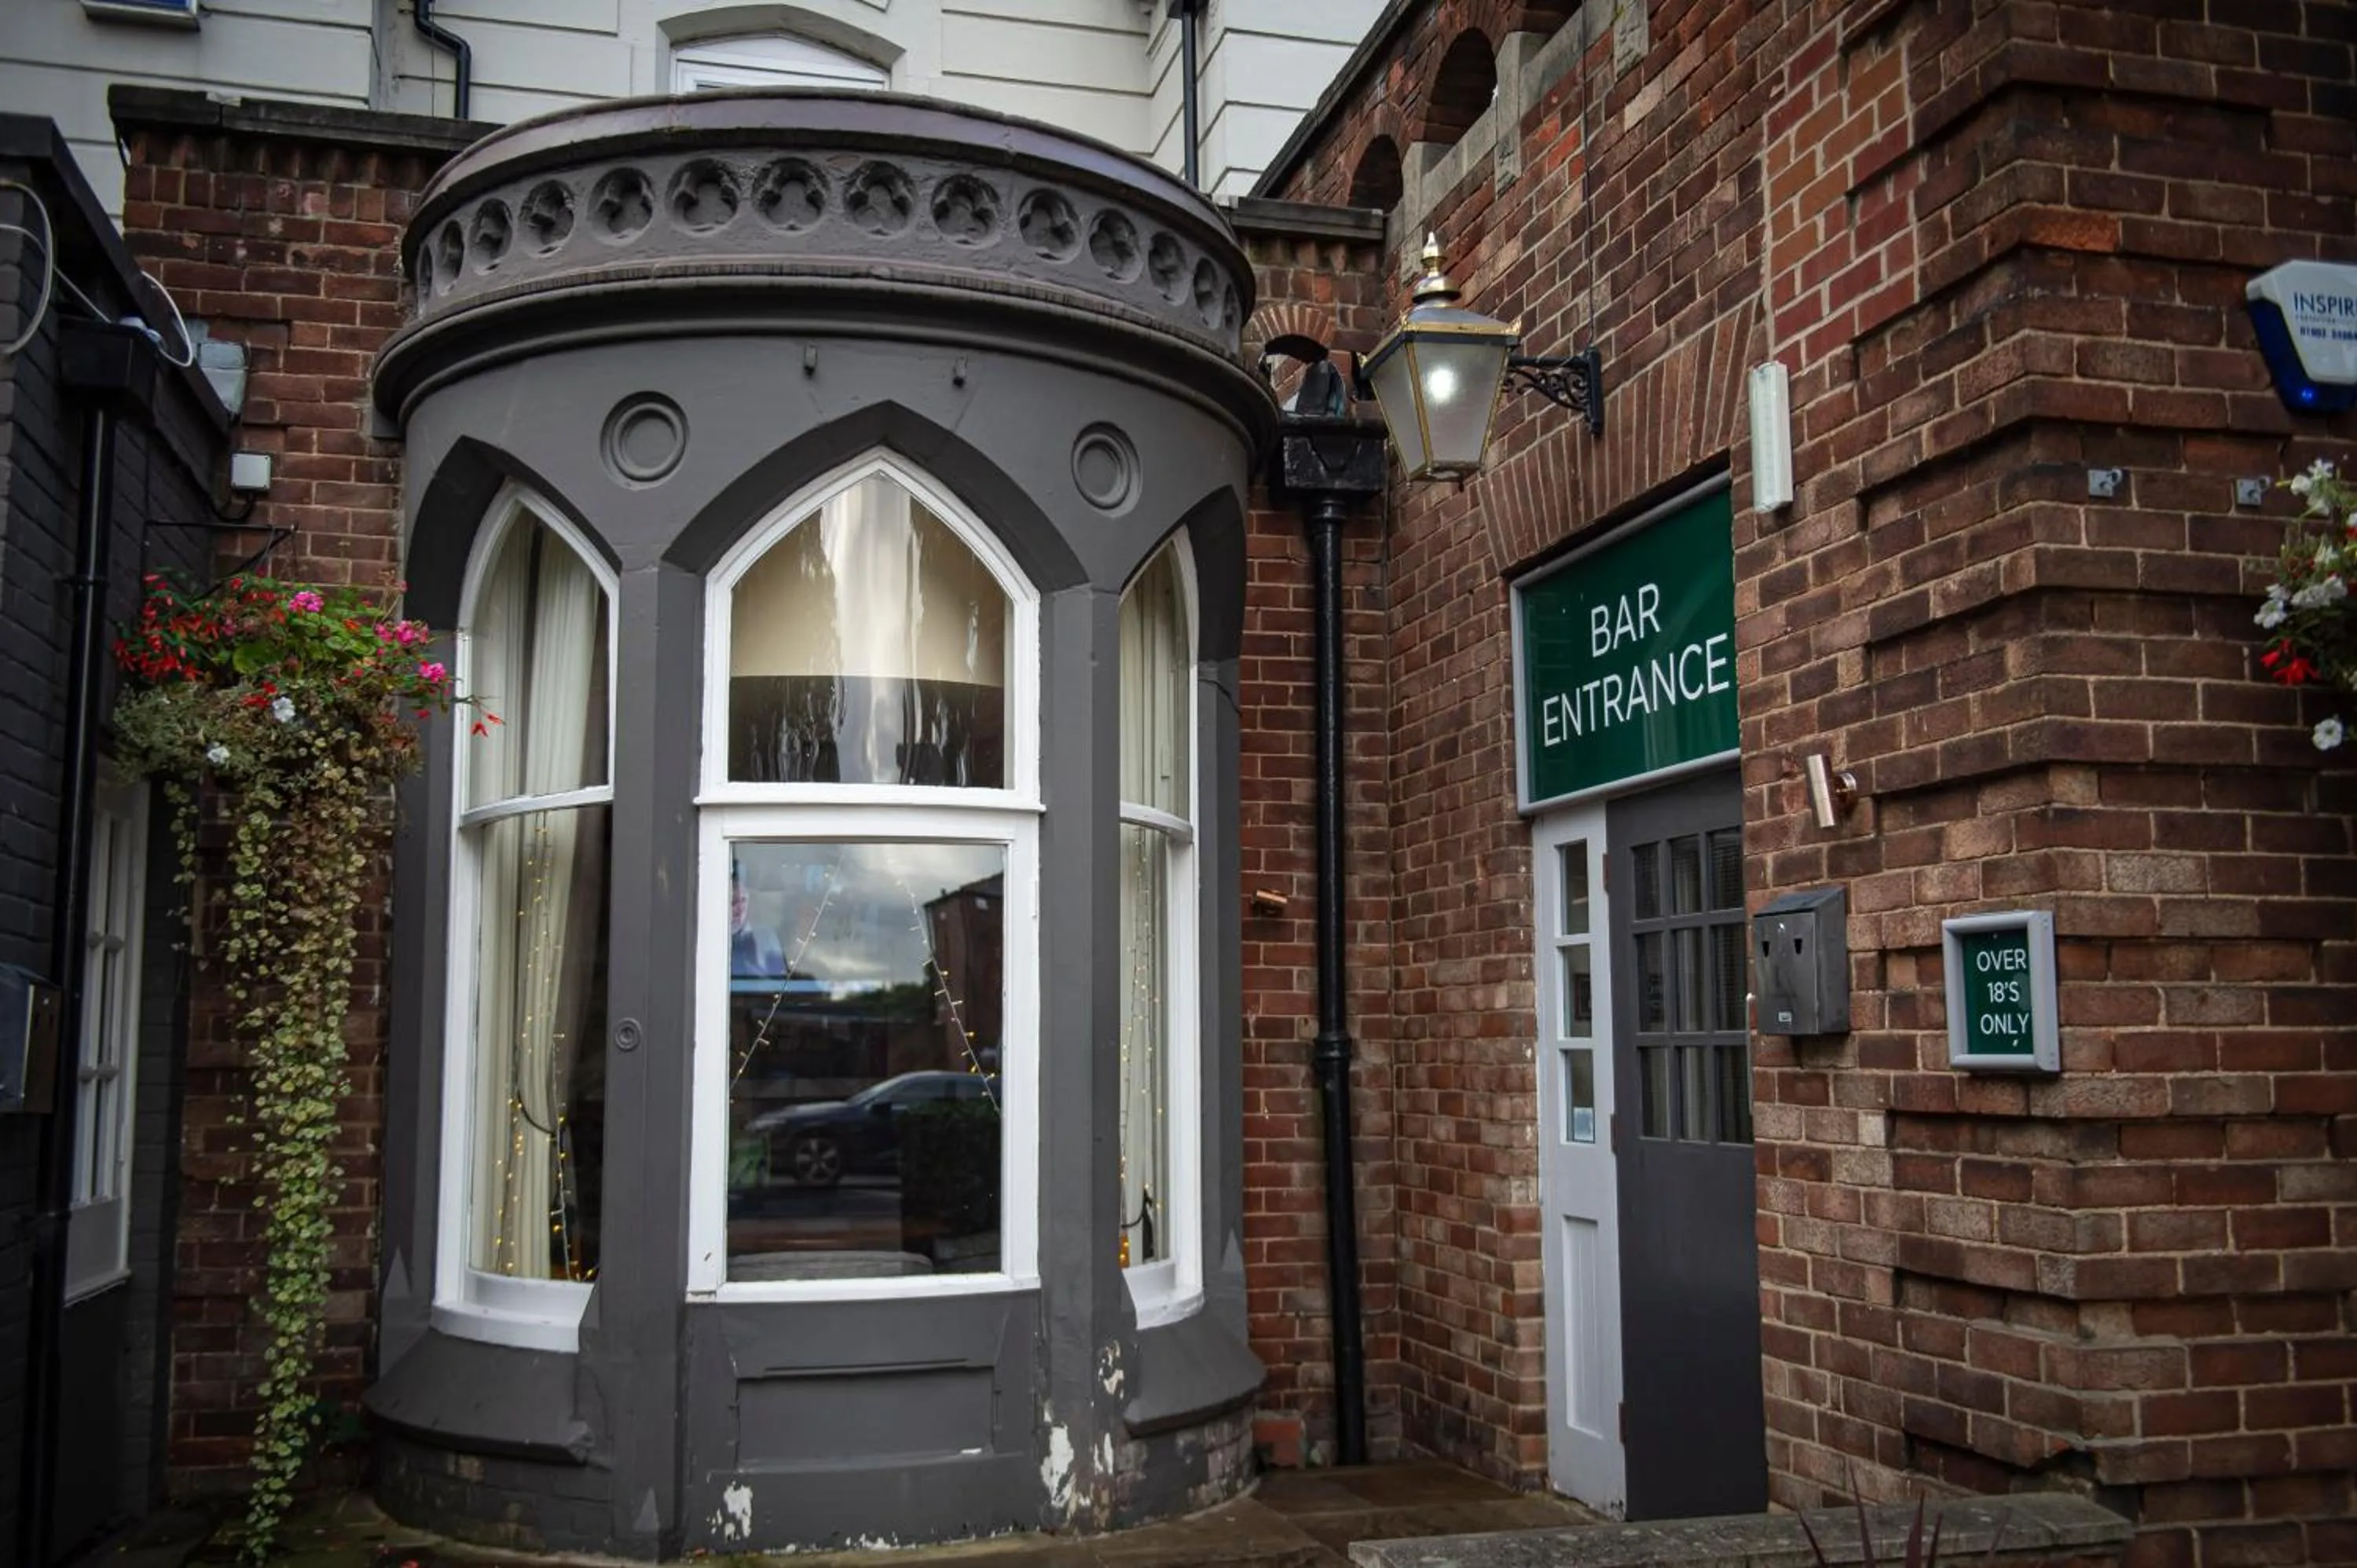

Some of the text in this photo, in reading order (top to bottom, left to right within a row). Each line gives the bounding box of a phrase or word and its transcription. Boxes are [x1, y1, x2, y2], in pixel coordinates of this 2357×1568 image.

[2293, 291, 2357, 317] INSPIR
[1591, 583, 1660, 658] BAR
[1543, 633, 1729, 747] ENTRANCE
[1976, 948, 2027, 972] OVER
[1987, 981, 2020, 1003] 18'S
[1980, 1013, 2029, 1035] ONLY
